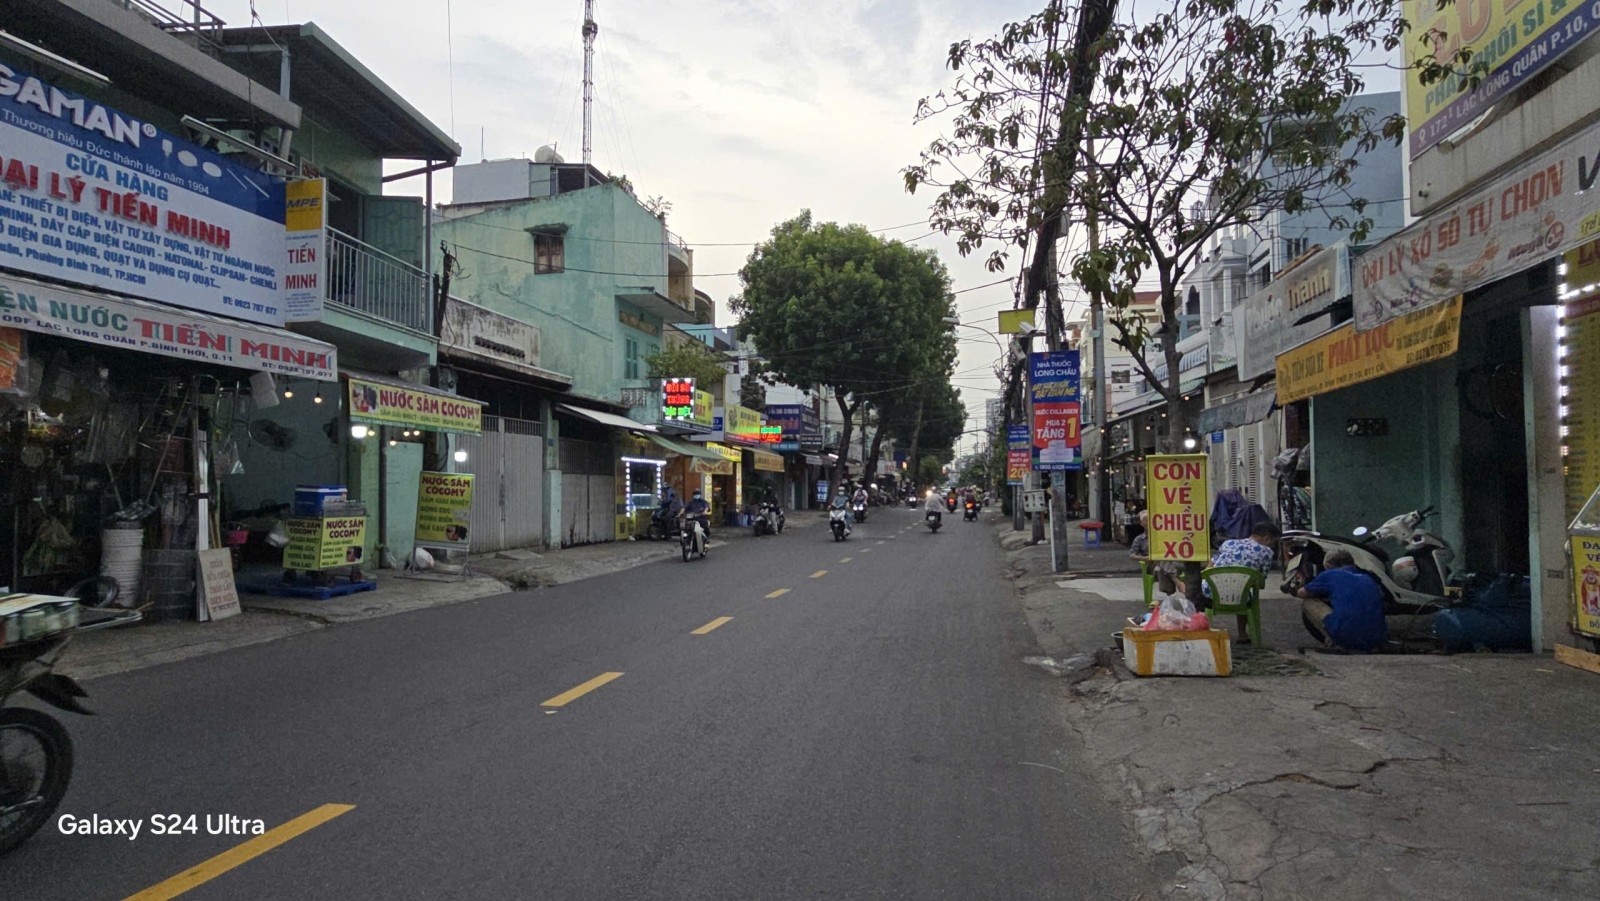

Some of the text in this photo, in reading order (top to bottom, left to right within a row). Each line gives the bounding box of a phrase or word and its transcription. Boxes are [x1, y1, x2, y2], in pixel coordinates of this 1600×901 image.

[1480, 70, 1510, 101] LONG
[1512, 44, 1547, 76] QUÂN
[2, 108, 53, 138] Thương
[58, 130, 82, 147] hiệu
[86, 140, 110, 158] Đức
[188, 180, 209, 195] 1994
[66, 153, 168, 202] CỬA HÀNG
[50, 171, 86, 203] LÝ
[96, 187, 158, 227] TIẾN
[167, 210, 231, 249] MINH
[42, 234, 62, 249] GIA
[288, 243, 315, 264] TIẾN
[286, 274, 317, 290] MINH
[49, 300, 129, 332] NƯỚC
[133, 318, 228, 352] TIẾN
[240, 339, 327, 370] MINH
[1034, 366, 1076, 377] LONG CHÂU
[380, 388, 413, 411] NƯỚC
[441, 402, 480, 420] COCOMY
[1036, 417, 1077, 442] TẶNG 1
[426, 486, 466, 497] COCOMY
[1163, 482, 1192, 505] VÉ
[1152, 506, 1205, 531] CHIỀU
[329, 529, 360, 539] COCOMY
[1163, 532, 1194, 559] XỔ
